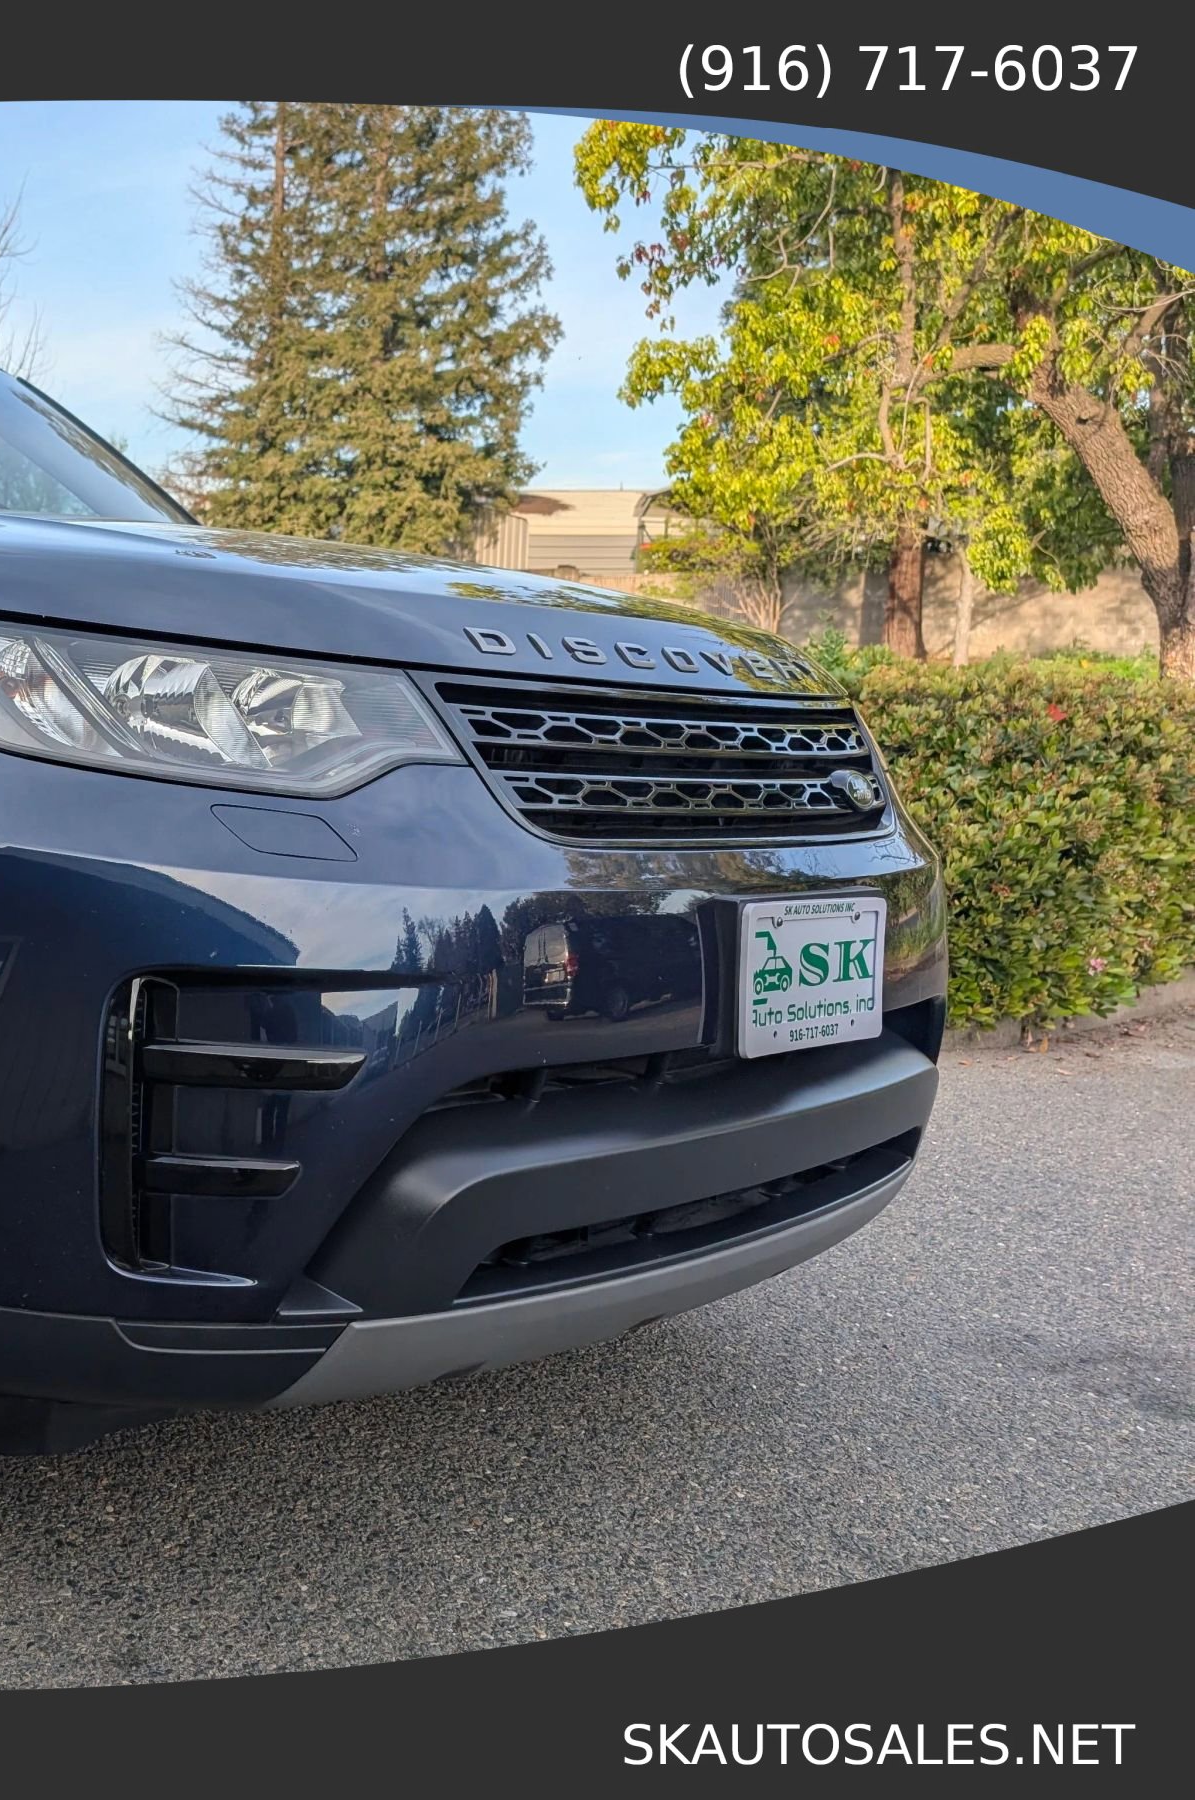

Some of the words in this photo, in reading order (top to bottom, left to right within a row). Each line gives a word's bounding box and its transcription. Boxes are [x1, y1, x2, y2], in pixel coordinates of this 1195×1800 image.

[463, 626, 820, 683] DISCOVERY
[784, 905, 794, 916] SK
[793, 904, 811, 915] AUTO
[811, 902, 845, 915] SOLUTIONS
[844, 902, 856, 913] INC
[799, 938, 876, 988] SK
[787, 998, 852, 1023] Solutions,
[789, 1023, 839, 1043] 916-717-6037
